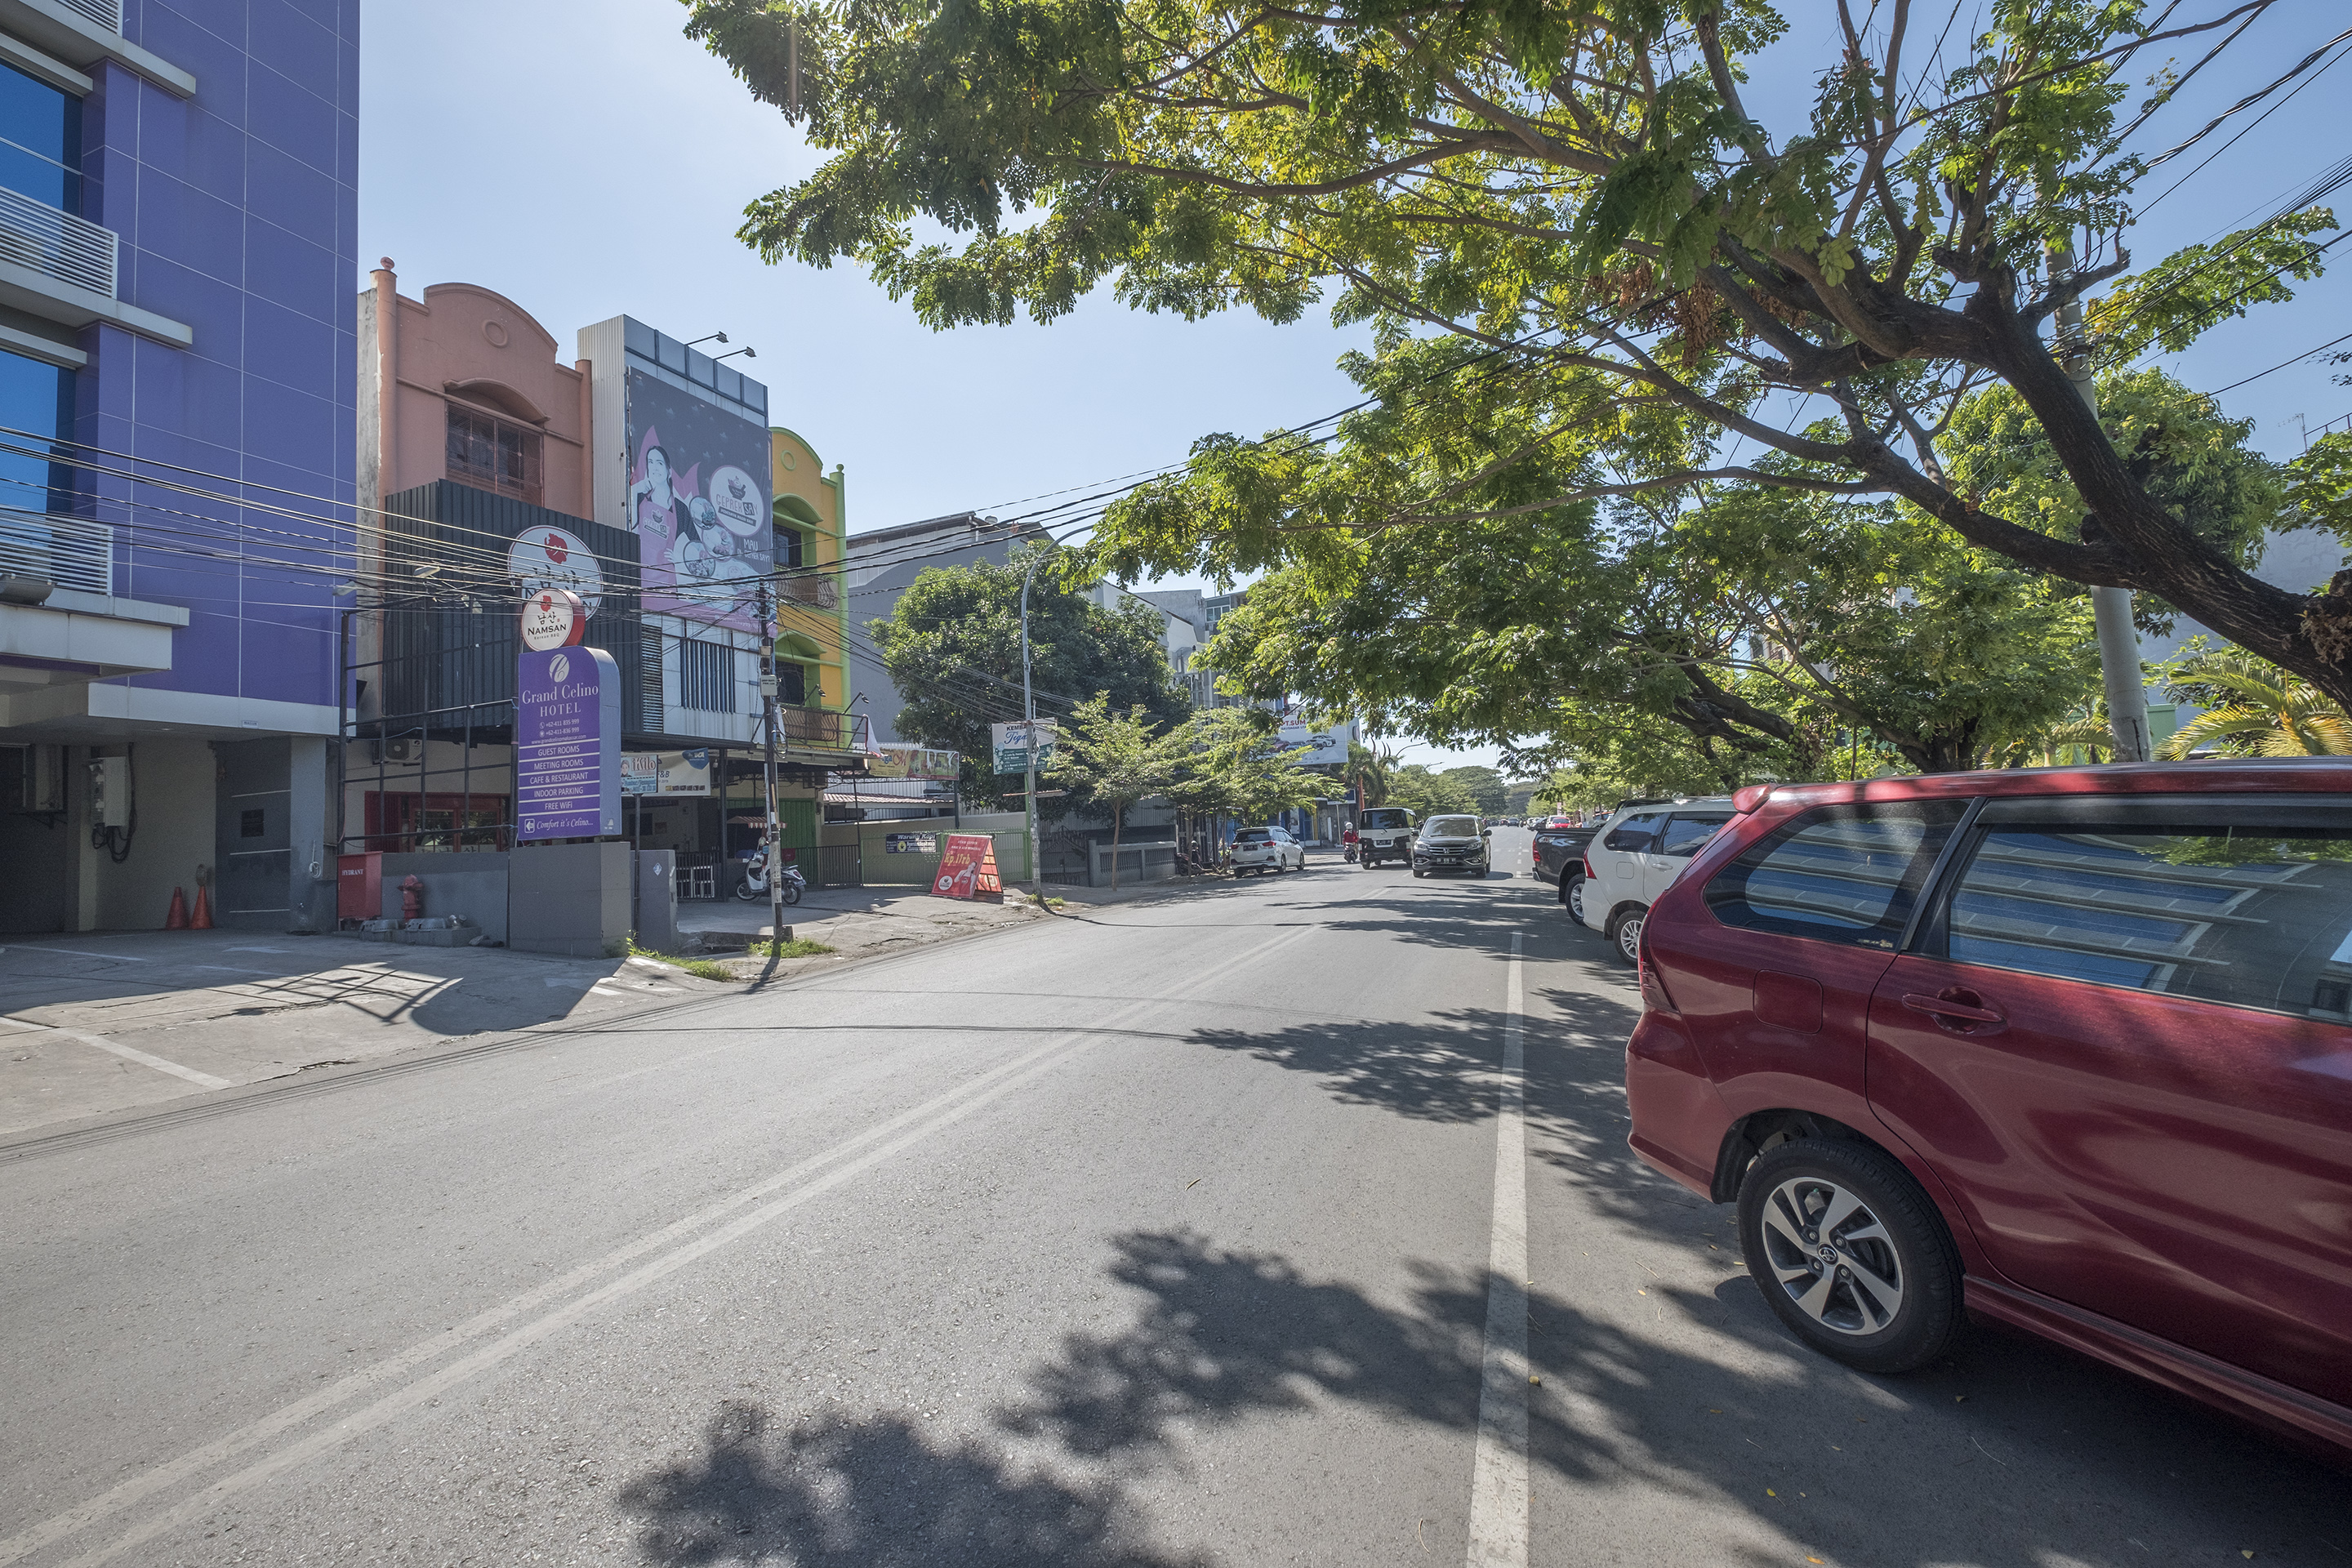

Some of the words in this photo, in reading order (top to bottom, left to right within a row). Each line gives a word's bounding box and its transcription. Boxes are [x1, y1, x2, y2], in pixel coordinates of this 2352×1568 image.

[715, 493, 742, 513] GEPREK
[744, 502, 759, 515] SAY
[744, 538, 758, 551] MAU
[528, 623, 567, 636] NAMSAN
[522, 686, 558, 704] Grand
[561, 682, 599, 700] Celino
[540, 702, 581, 717] HOTEL
[538, 746, 556, 756] GUEST
[557, 745, 580, 755] ROOMS
[534, 760, 560, 770] MEETING
[561, 758, 584, 768] ROOMS
[631, 756, 656, 771] iKilo
[530, 775, 544, 785] CAFE
[545, 775, 550, 783] &
[551, 772, 589, 782] RESTAURANT
[534, 788, 558, 798] INDOOR
[559, 786, 584, 795] PARKING
[545, 801, 559, 810] FREE
[559, 800, 572, 809] WiFi
[537, 819, 559, 831] Comfort
[559, 817, 570, 827] it's
[944, 853, 971, 866] Rp.17rb
